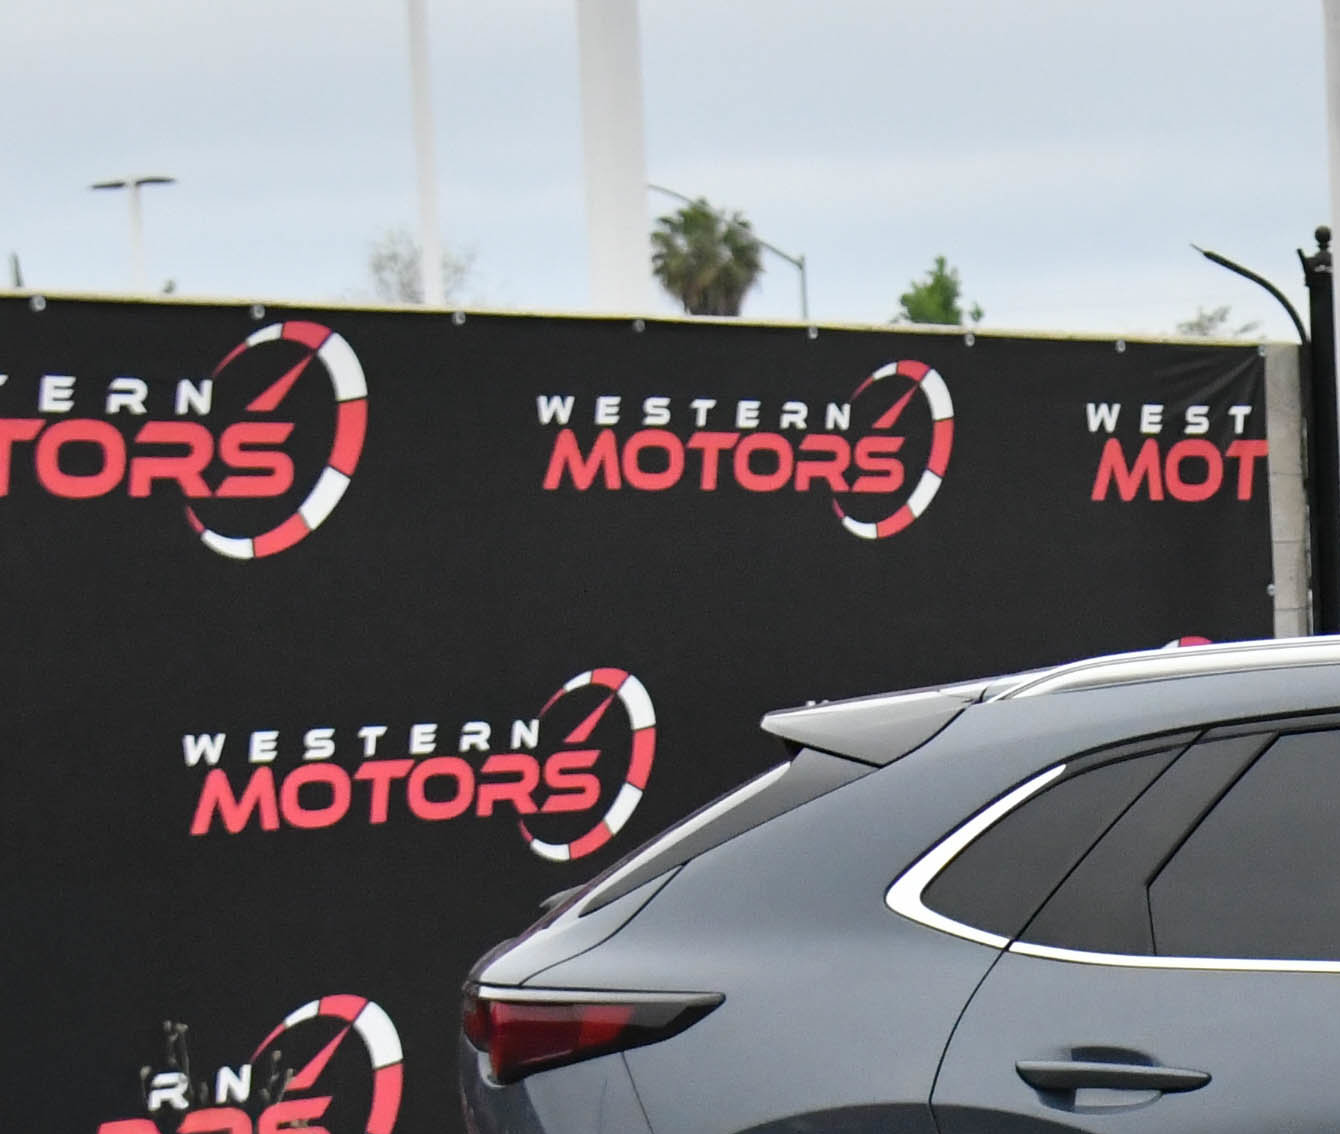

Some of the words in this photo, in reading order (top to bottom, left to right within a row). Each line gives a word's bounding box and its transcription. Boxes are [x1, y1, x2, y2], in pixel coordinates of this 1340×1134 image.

[0, 374, 213, 415] ERN
[537, 395, 851, 431] WESTERN
[1086, 402, 1252, 434] WEST
[543, 428, 905, 493] MOTORS
[1091, 437, 1269, 502] MOT
[183, 719, 540, 766] WESTERN
[190, 749, 601, 836] MOTORS
